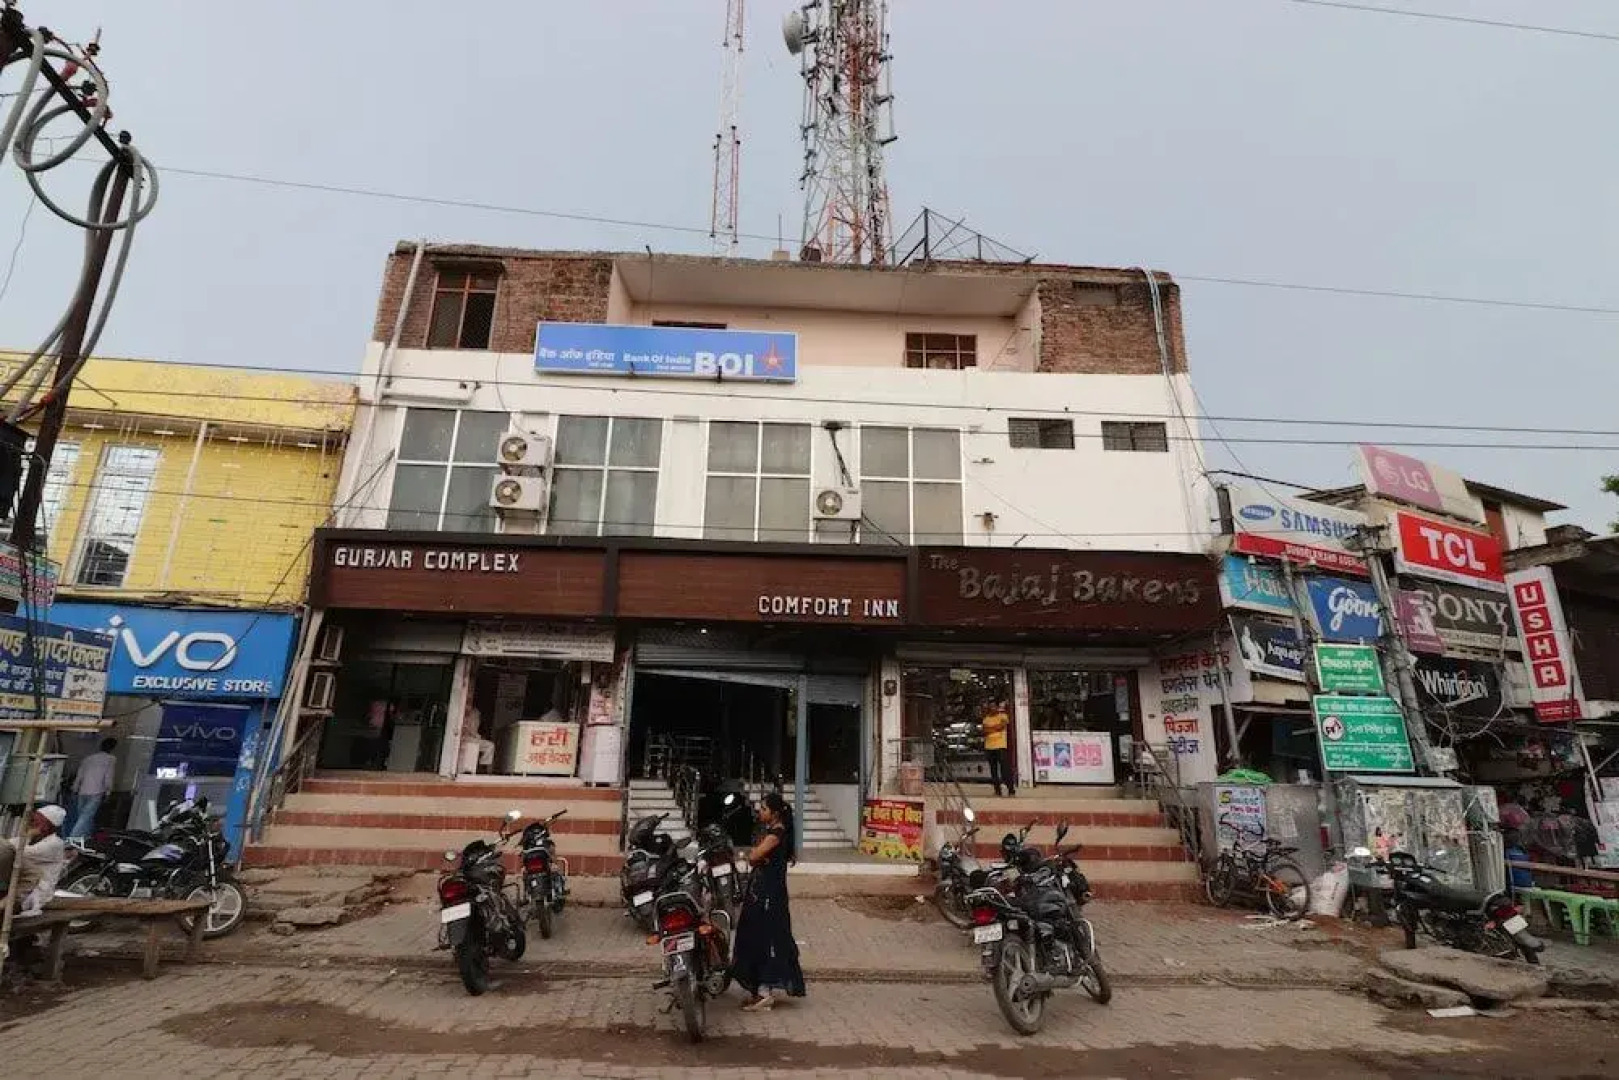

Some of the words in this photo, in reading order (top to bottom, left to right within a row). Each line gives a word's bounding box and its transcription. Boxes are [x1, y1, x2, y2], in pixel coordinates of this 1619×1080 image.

[694, 352, 754, 376] BOI
[1402, 465, 1430, 493] LG
[334, 546, 412, 568] GURJAR
[424, 551, 519, 573] COMPLEX
[930, 555, 958, 570] The
[1420, 526, 1487, 572] TCL
[959, 564, 1061, 605] Bajaj
[758, 595, 853, 617] COMFORT
[864, 599, 900, 617] INN
[1416, 590, 1508, 626] SONY
[96, 614, 236, 671] ivo
[1521, 585, 1560, 685] USHA
[132, 674, 217, 691] EXCLUSIVE
[172, 722, 237, 741] vivo
